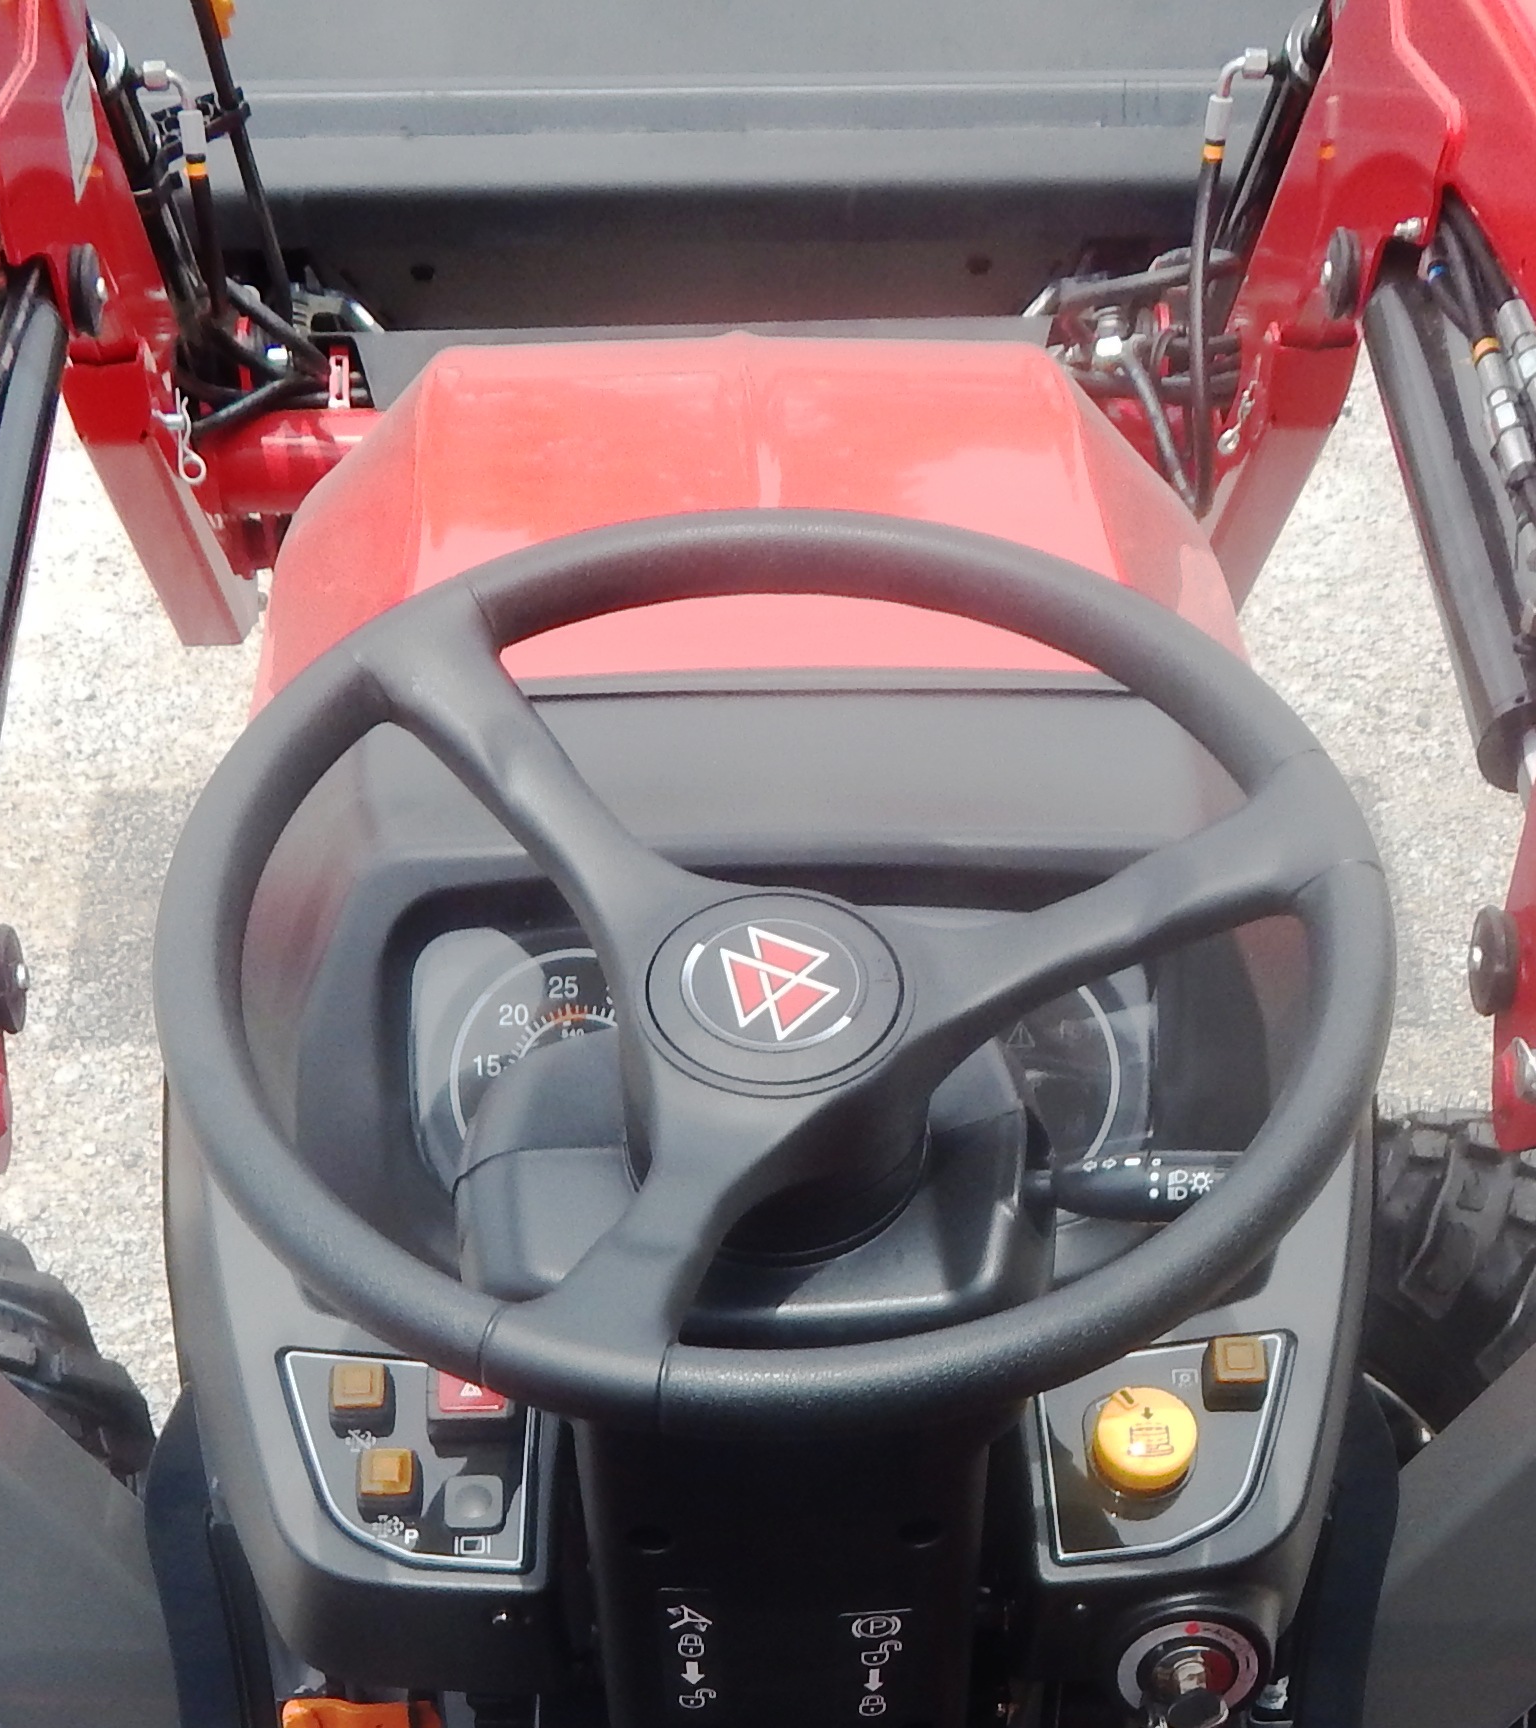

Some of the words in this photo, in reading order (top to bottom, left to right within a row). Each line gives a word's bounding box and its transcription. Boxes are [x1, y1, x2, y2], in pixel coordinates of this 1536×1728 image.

[548, 976, 579, 999] 25
[499, 1003, 529, 1026] 20
[473, 1054, 502, 1077] 15
[404, 1529, 419, 1545] P
